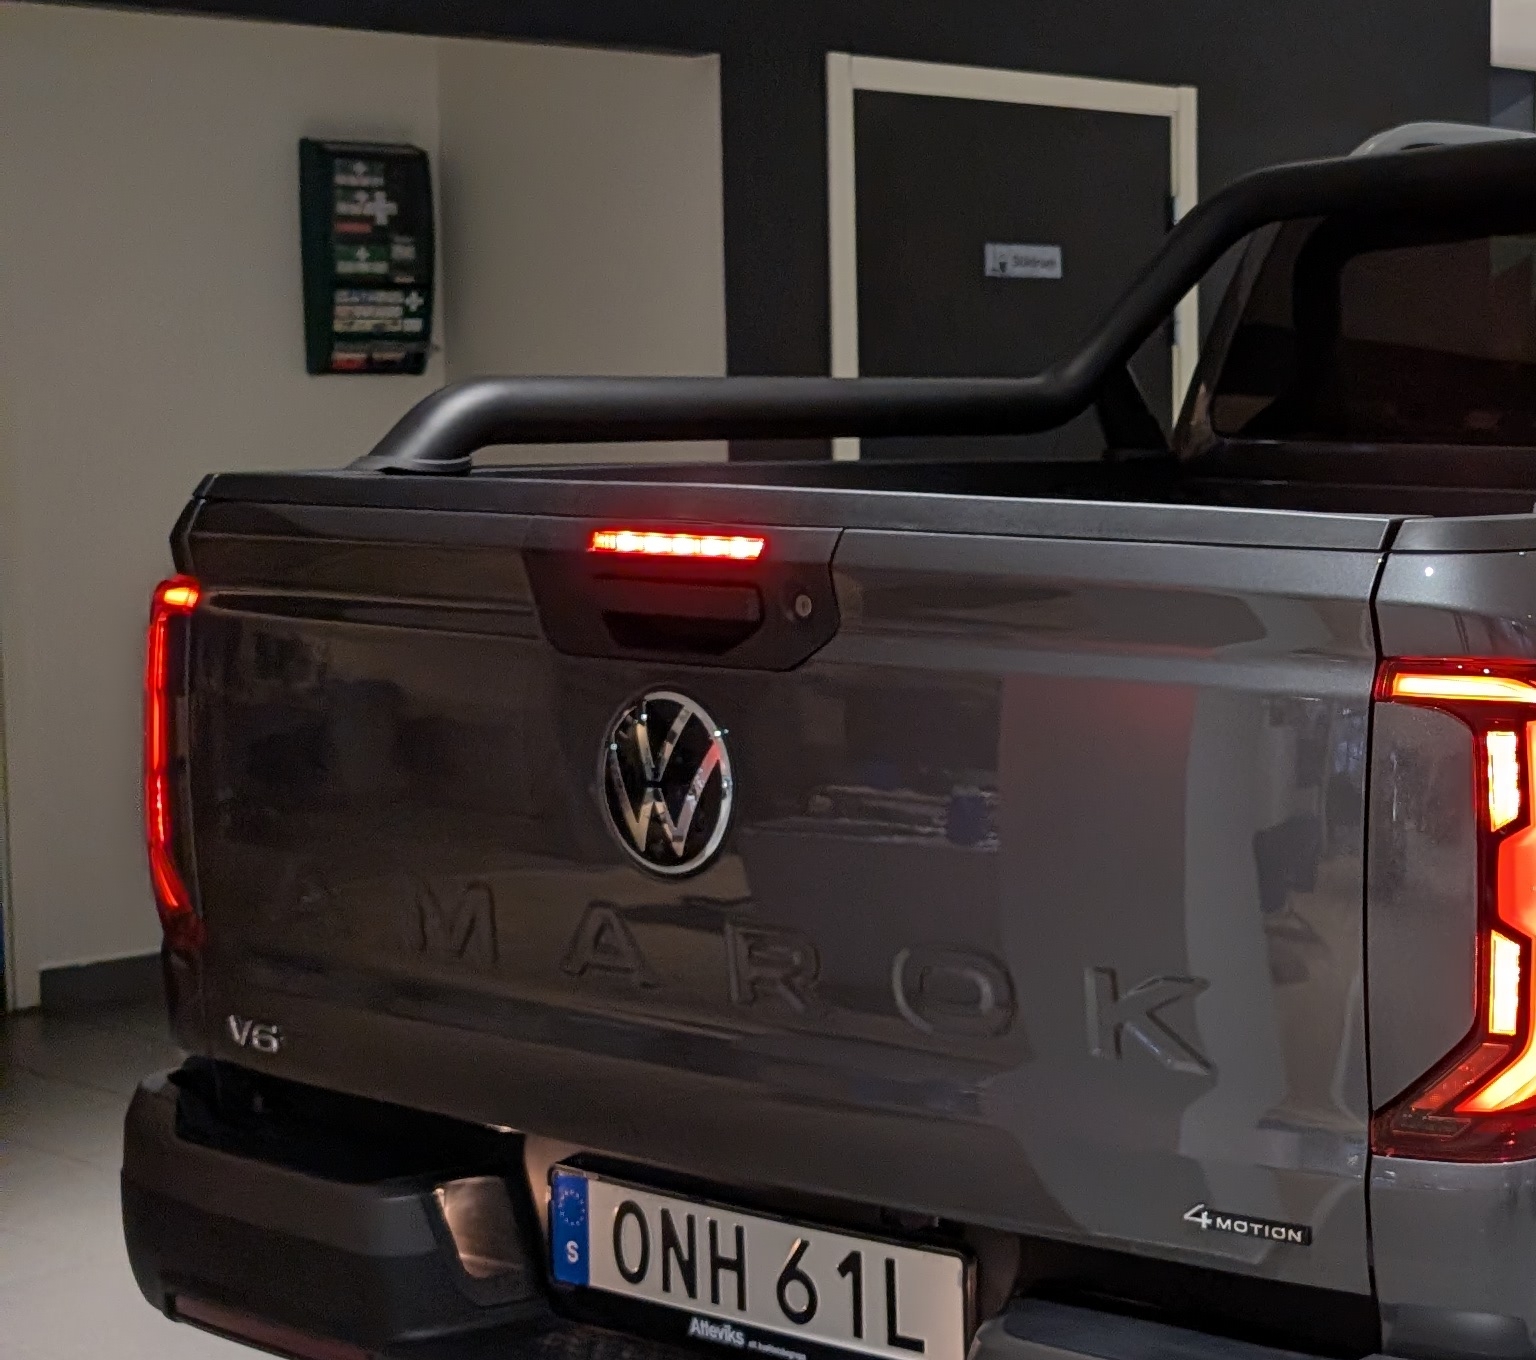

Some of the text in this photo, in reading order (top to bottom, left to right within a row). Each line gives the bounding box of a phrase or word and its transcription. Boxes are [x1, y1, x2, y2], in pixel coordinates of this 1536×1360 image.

[268, 862, 1216, 1077] MAROK
[228, 1014, 280, 1053] V6
[1183, 1203, 1303, 1243] 4MOTION
[565, 1240, 580, 1264] S
[612, 1199, 926, 1354] ONH 61L
